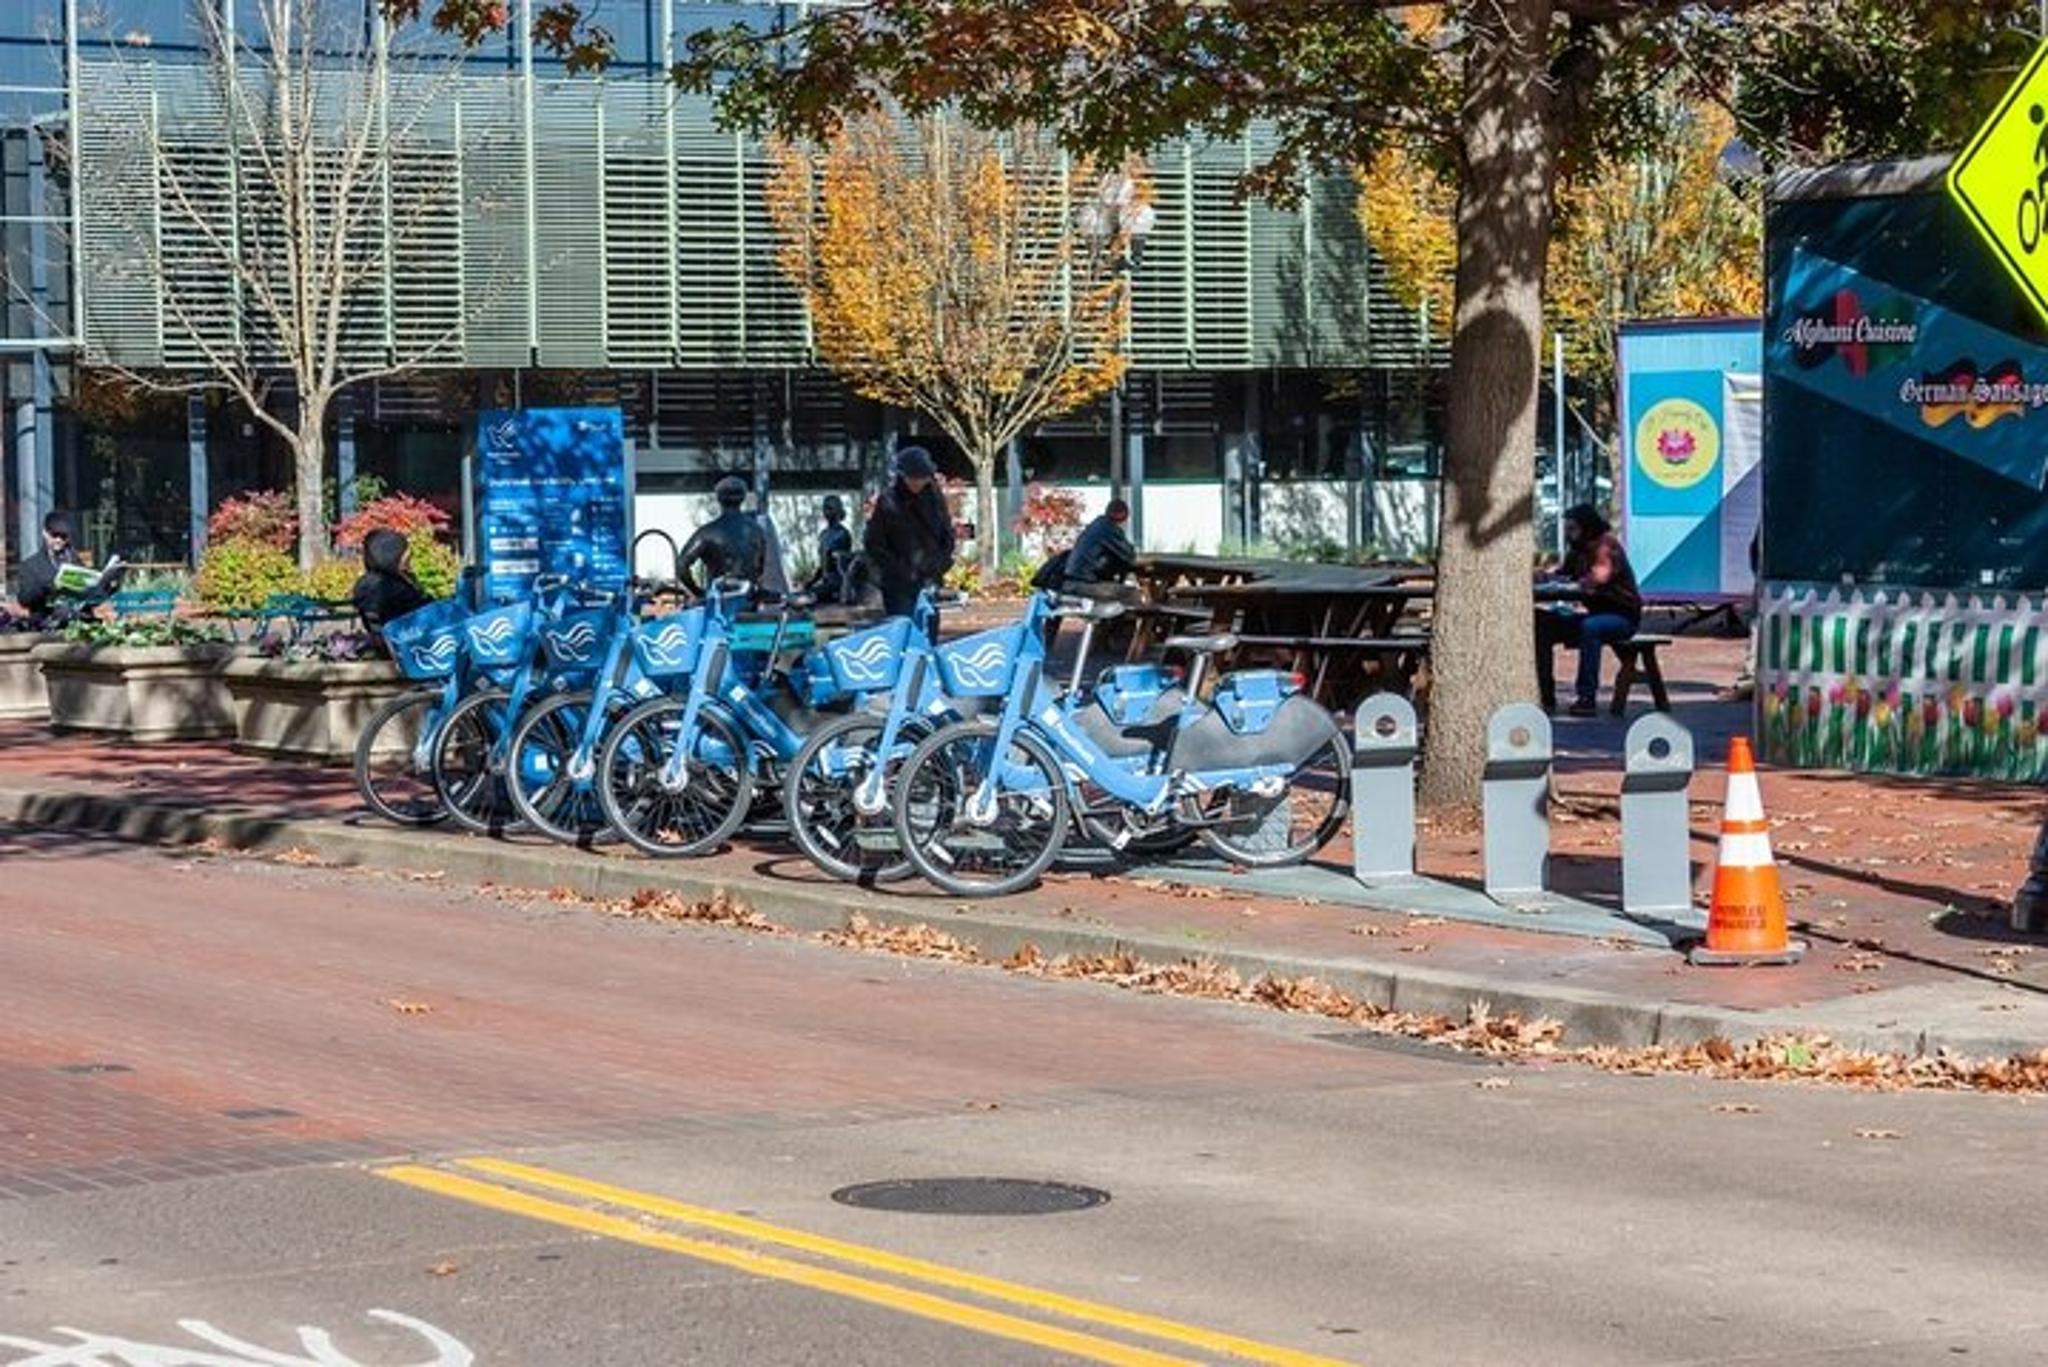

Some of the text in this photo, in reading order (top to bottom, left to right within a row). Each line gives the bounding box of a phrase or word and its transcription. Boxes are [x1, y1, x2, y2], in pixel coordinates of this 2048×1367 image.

[1783, 316, 1917, 349] Afghani Cuisine
[1899, 377, 1967, 403] German
